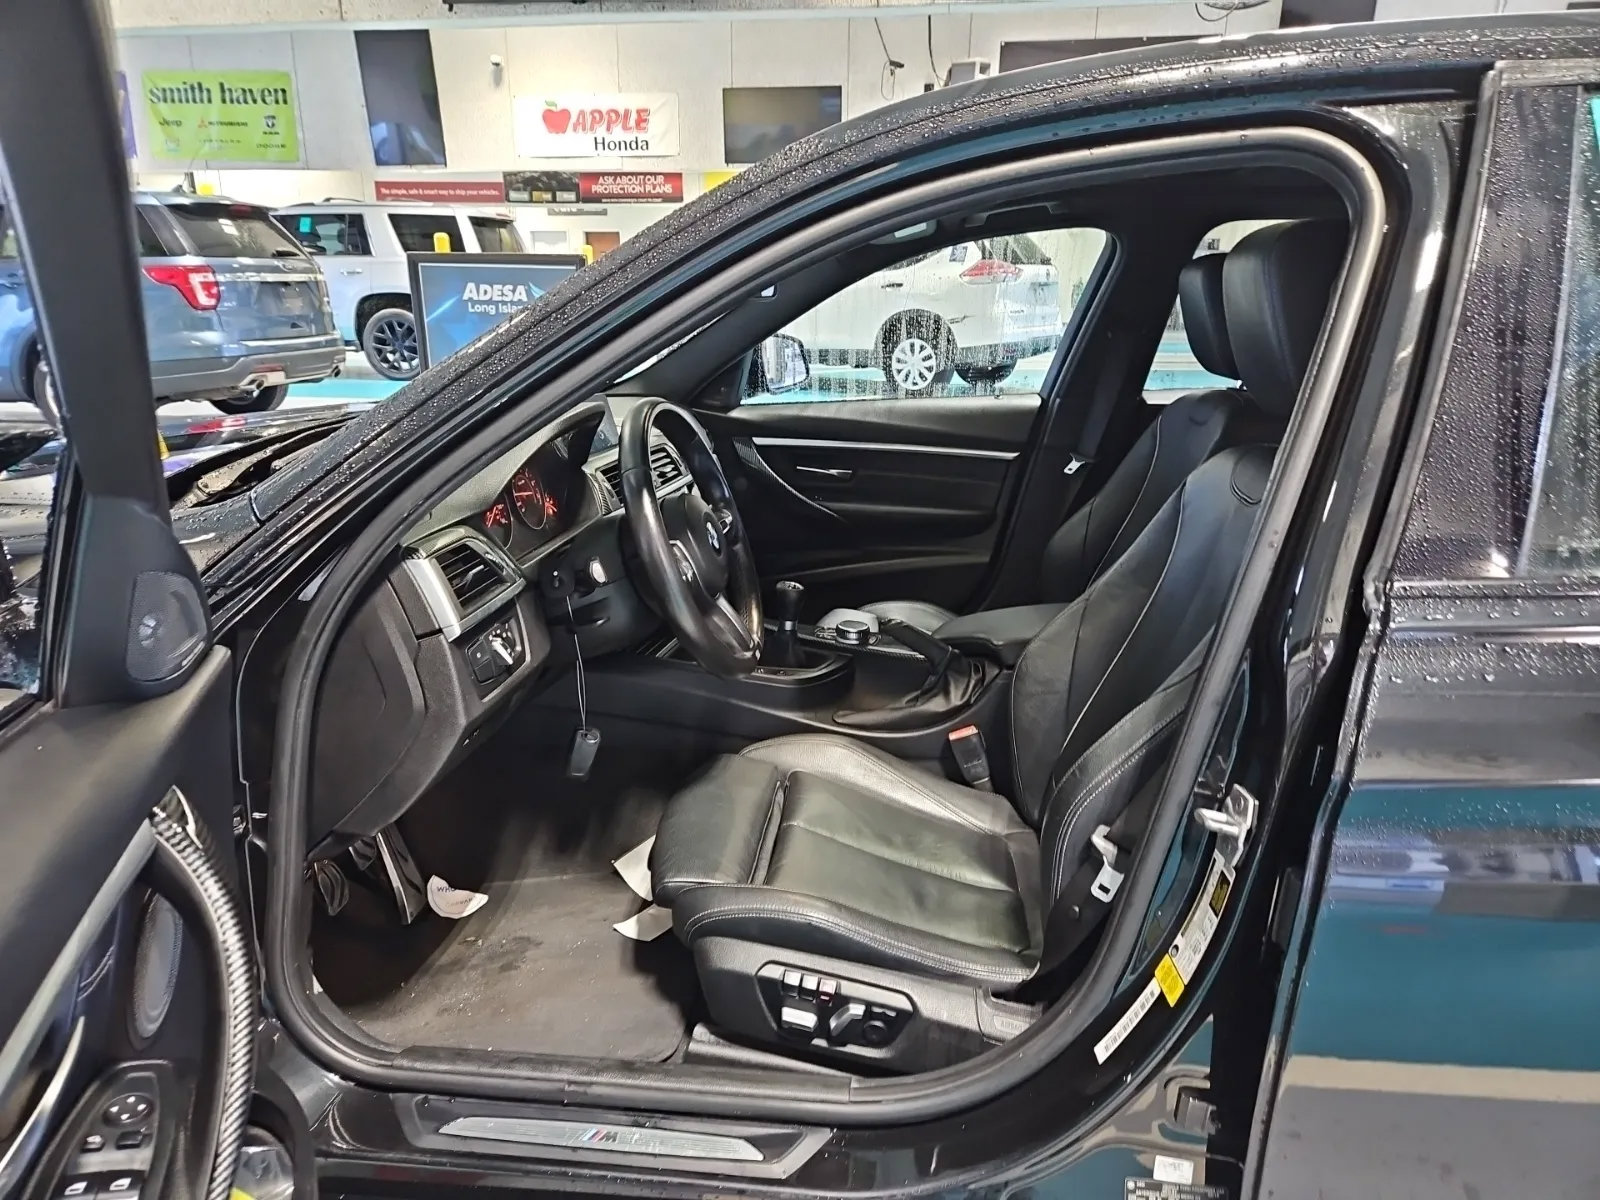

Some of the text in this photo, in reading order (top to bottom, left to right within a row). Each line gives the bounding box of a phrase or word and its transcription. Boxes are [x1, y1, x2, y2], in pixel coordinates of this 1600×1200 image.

[148, 81, 289, 105] smith haven
[573, 108, 650, 134] APPLE
[594, 136, 649, 151] Honda
[598, 175, 664, 184] ASK ABOUT OUR
[380, 187, 390, 195] The
[591, 184, 672, 194] PROTECTION PLANS
[462, 281, 528, 301] ADESA
[468, 302, 523, 315] Long Isla
